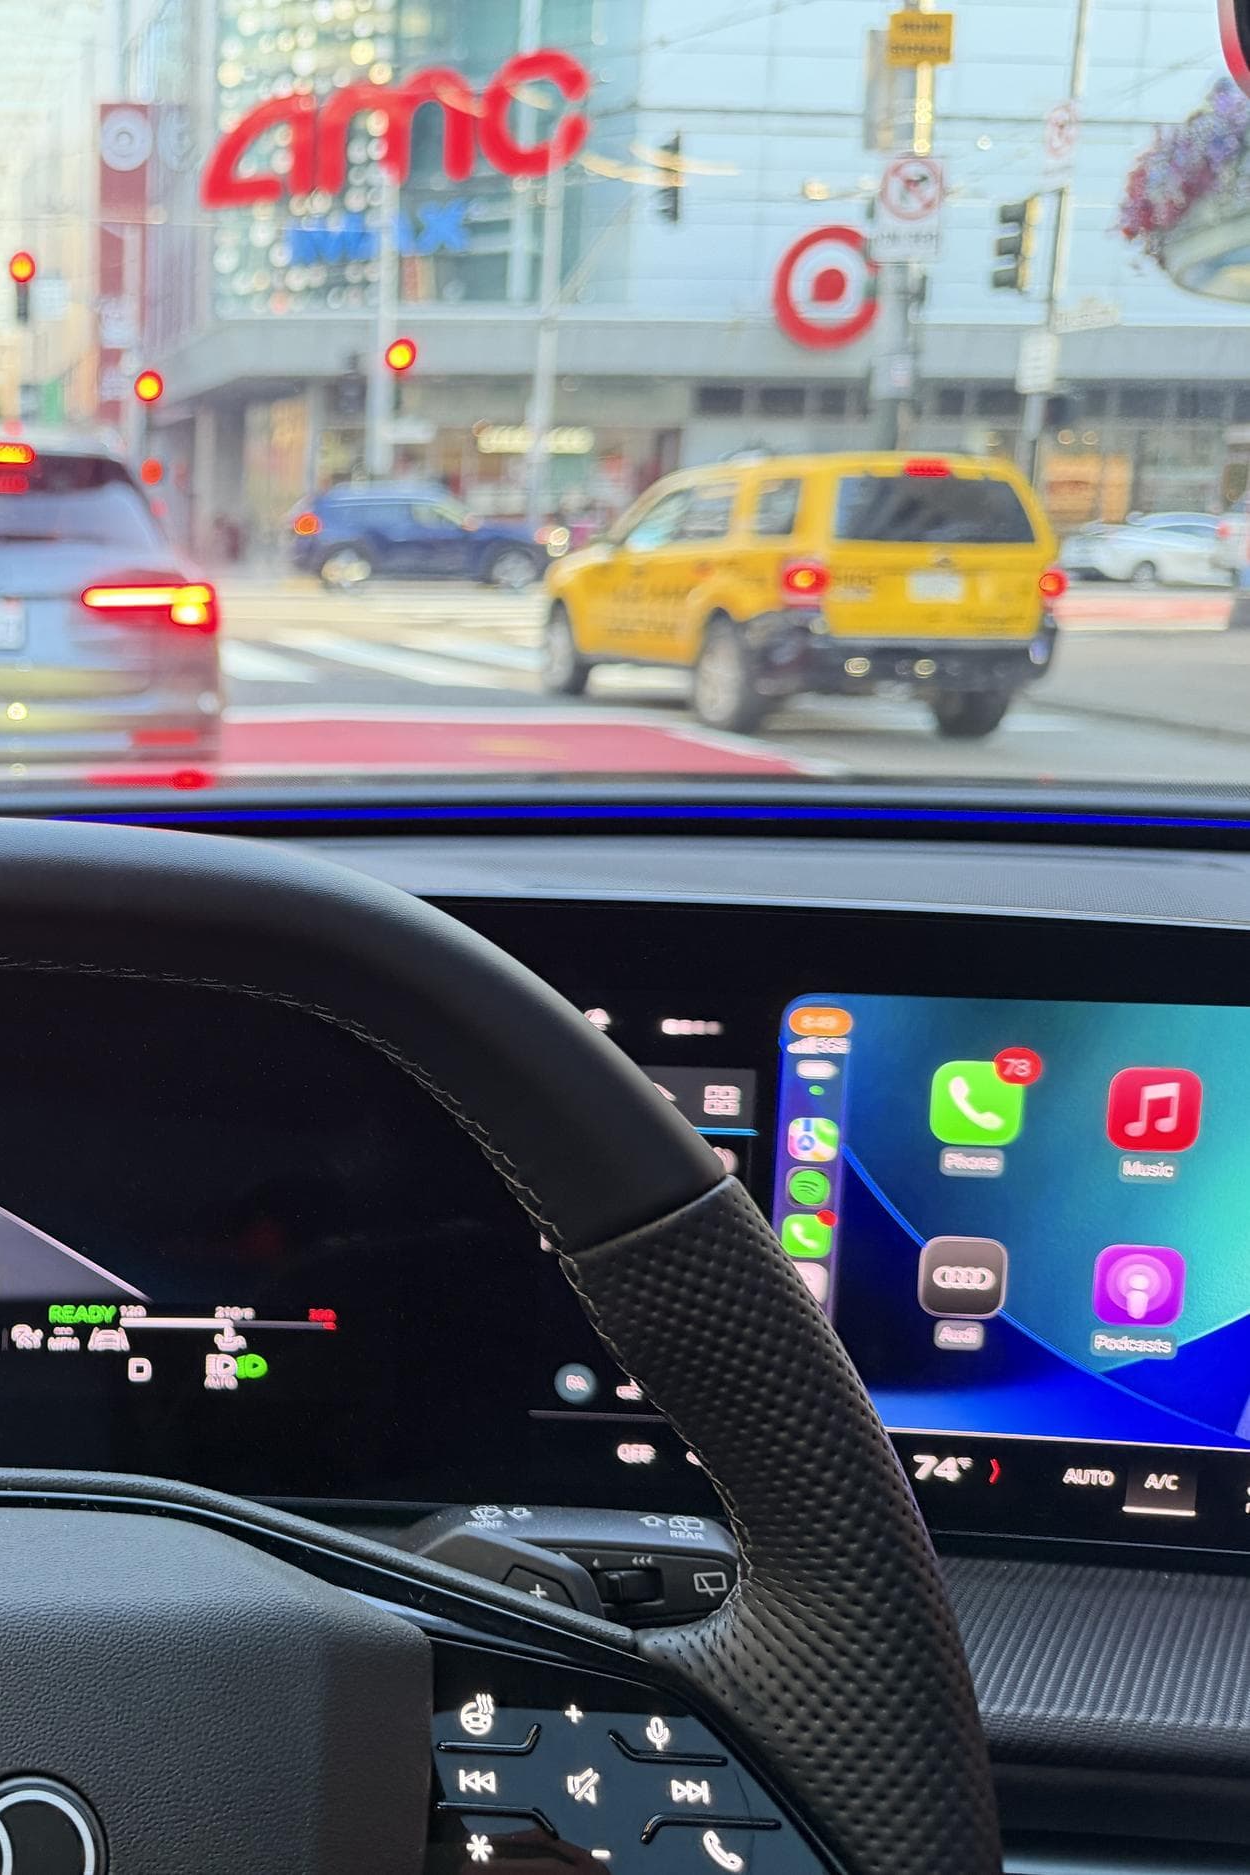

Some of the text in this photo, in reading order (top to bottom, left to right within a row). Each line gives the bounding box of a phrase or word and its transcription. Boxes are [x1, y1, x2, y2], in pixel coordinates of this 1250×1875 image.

[943, 1153, 1000, 1172] Phone
[1121, 1160, 1175, 1179] Music
[49, 1304, 117, 1324] READY
[939, 1326, 979, 1344] Audi
[1093, 1334, 1172, 1354] Podcasts
[128, 1356, 153, 1382] D
[1062, 1466, 1116, 1487] AUTO
[1143, 1472, 1180, 1491] A/C
[669, 1529, 705, 1541] REAR
